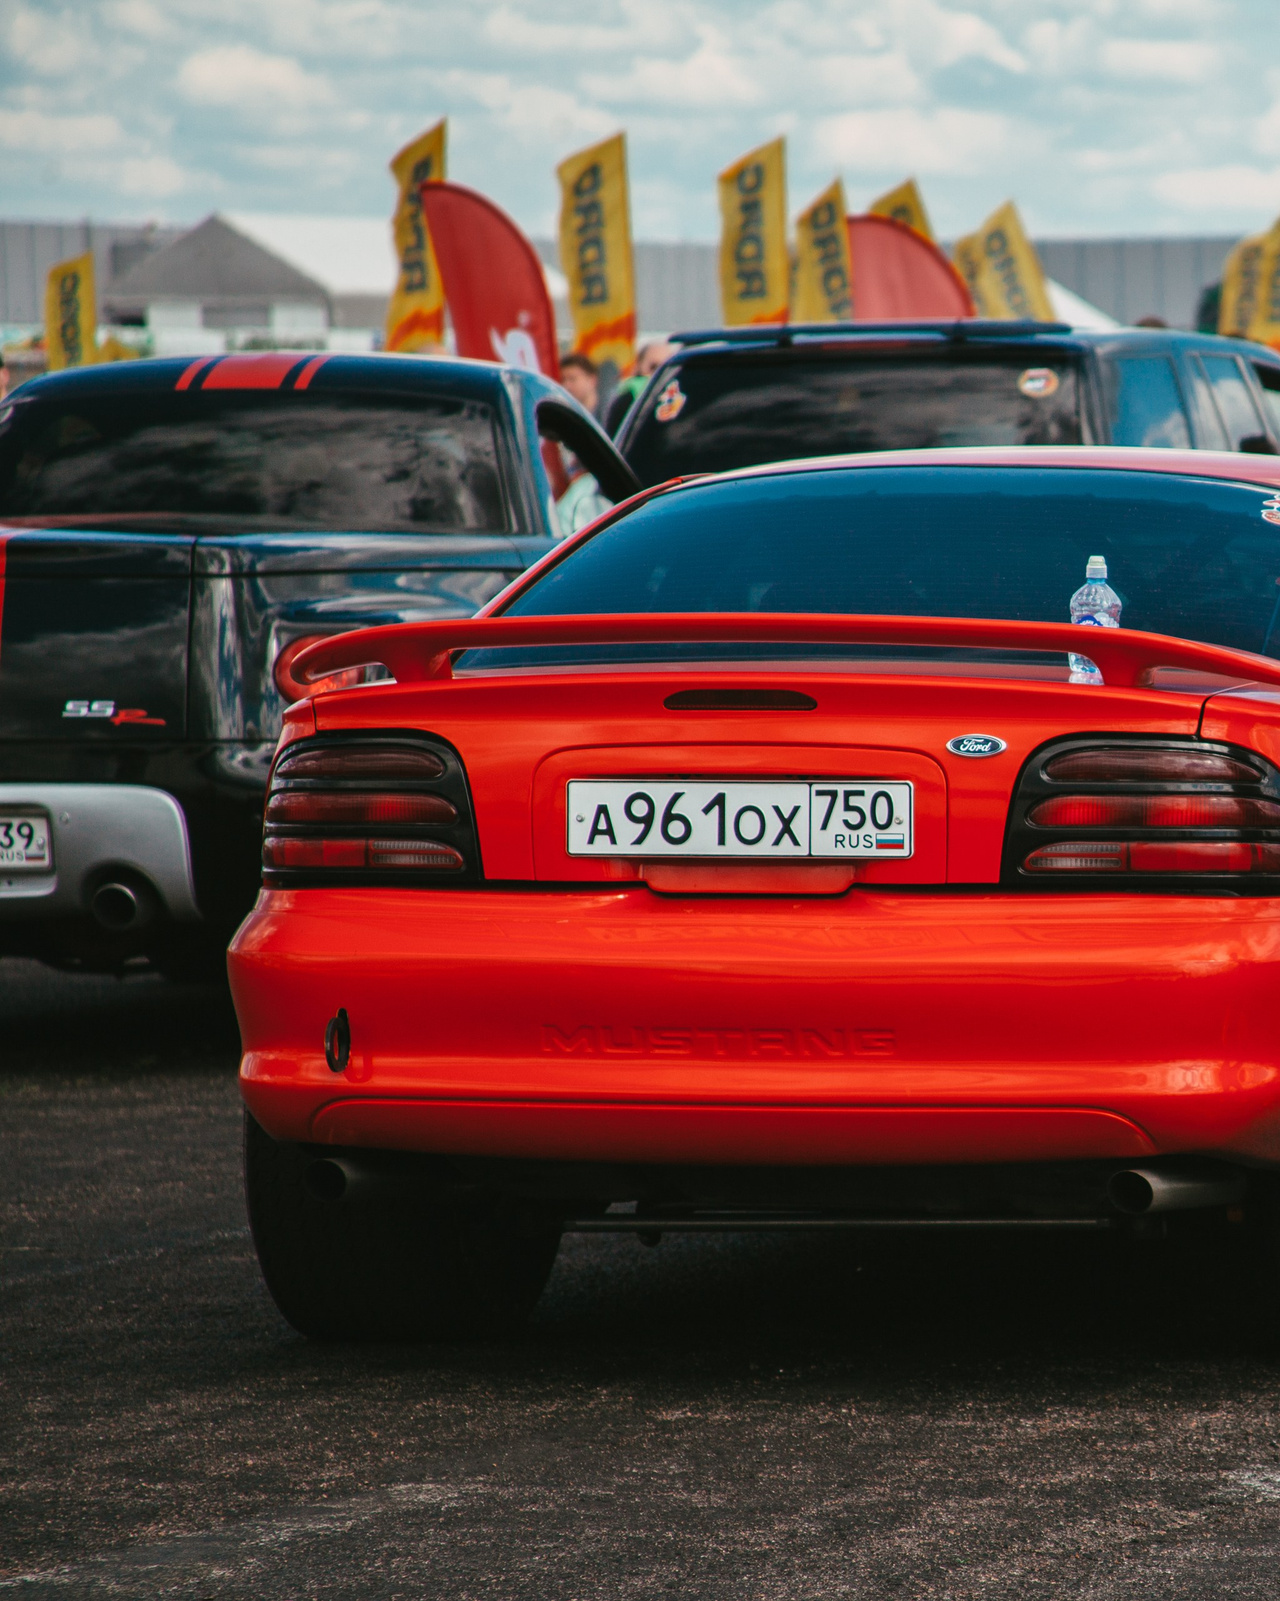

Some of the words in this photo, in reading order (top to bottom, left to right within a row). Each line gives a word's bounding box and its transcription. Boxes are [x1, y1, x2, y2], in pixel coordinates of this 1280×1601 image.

[959, 738, 992, 752] Ford
[814, 788, 895, 832] 750
[834, 833, 874, 850] RUS
[541, 1024, 897, 1057] MUSTANG
